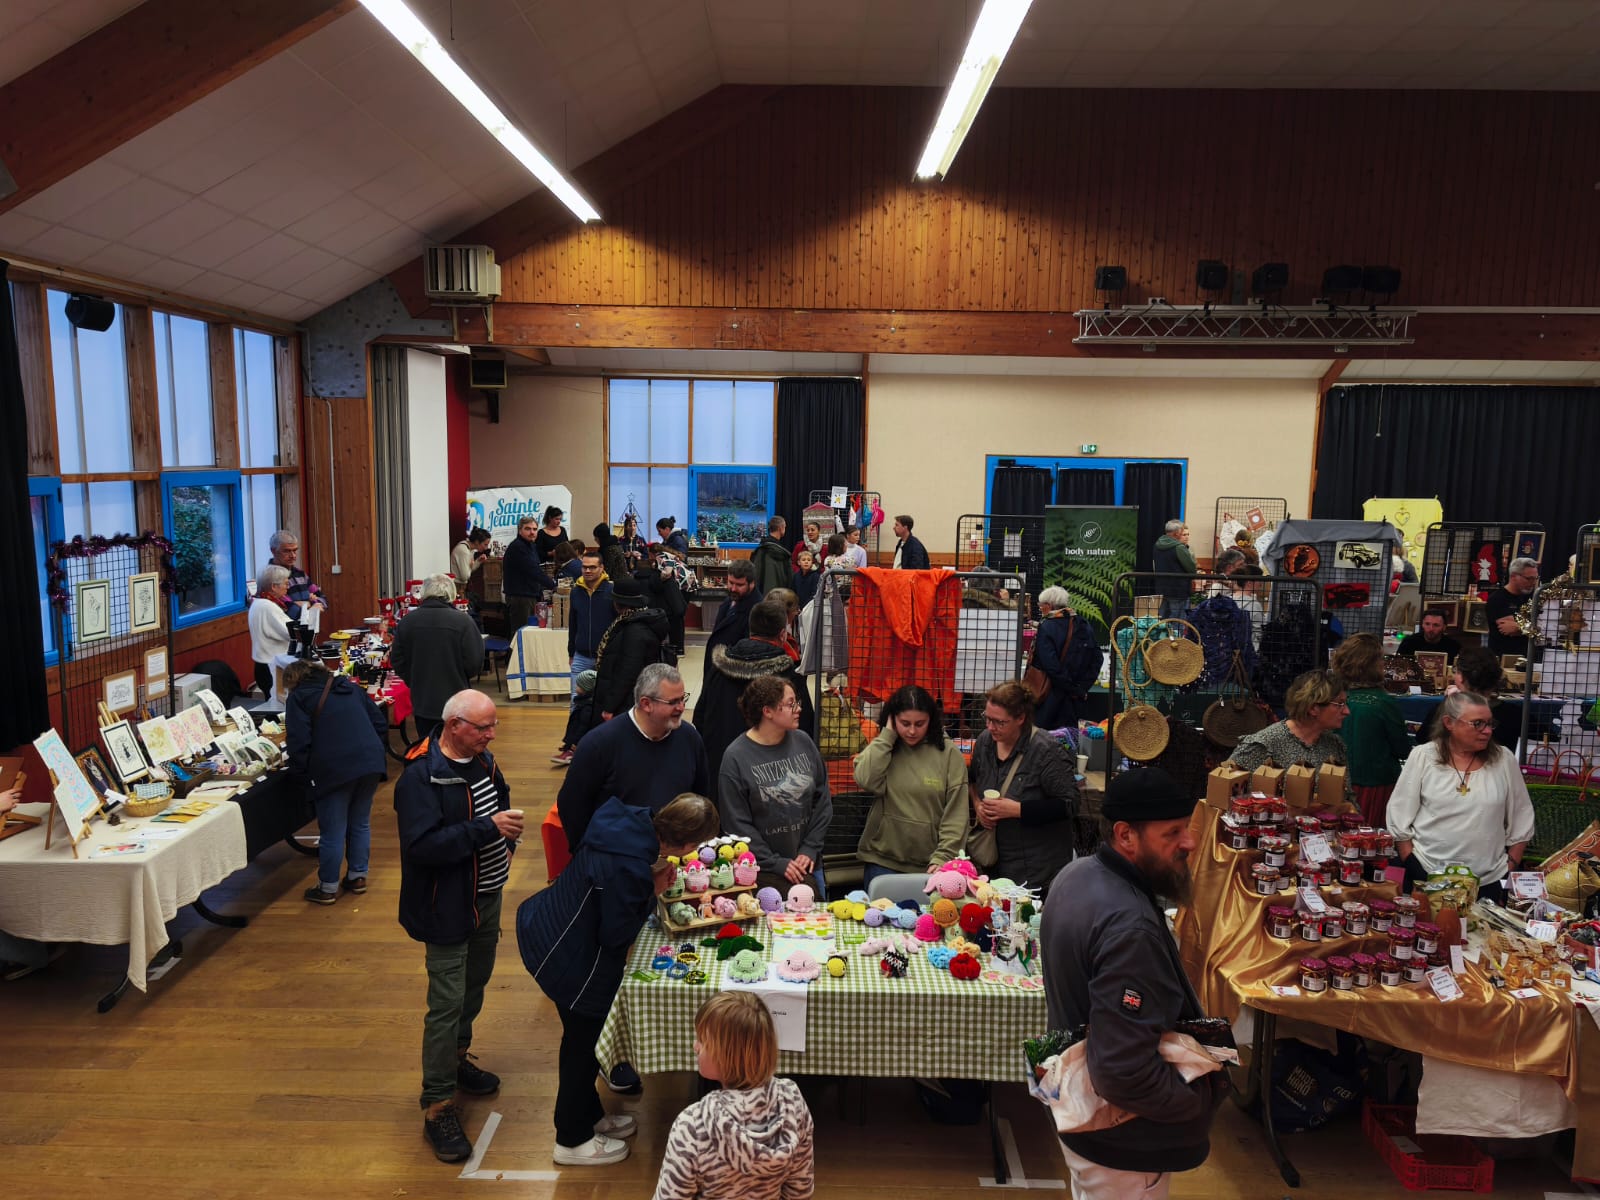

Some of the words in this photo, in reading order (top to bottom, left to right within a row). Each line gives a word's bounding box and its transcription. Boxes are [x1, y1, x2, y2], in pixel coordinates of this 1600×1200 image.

[496, 498, 541, 515] Sainte
[1065, 548, 1084, 557] body
[1087, 548, 1116, 556] nature
[765, 825, 789, 836] LAKE
